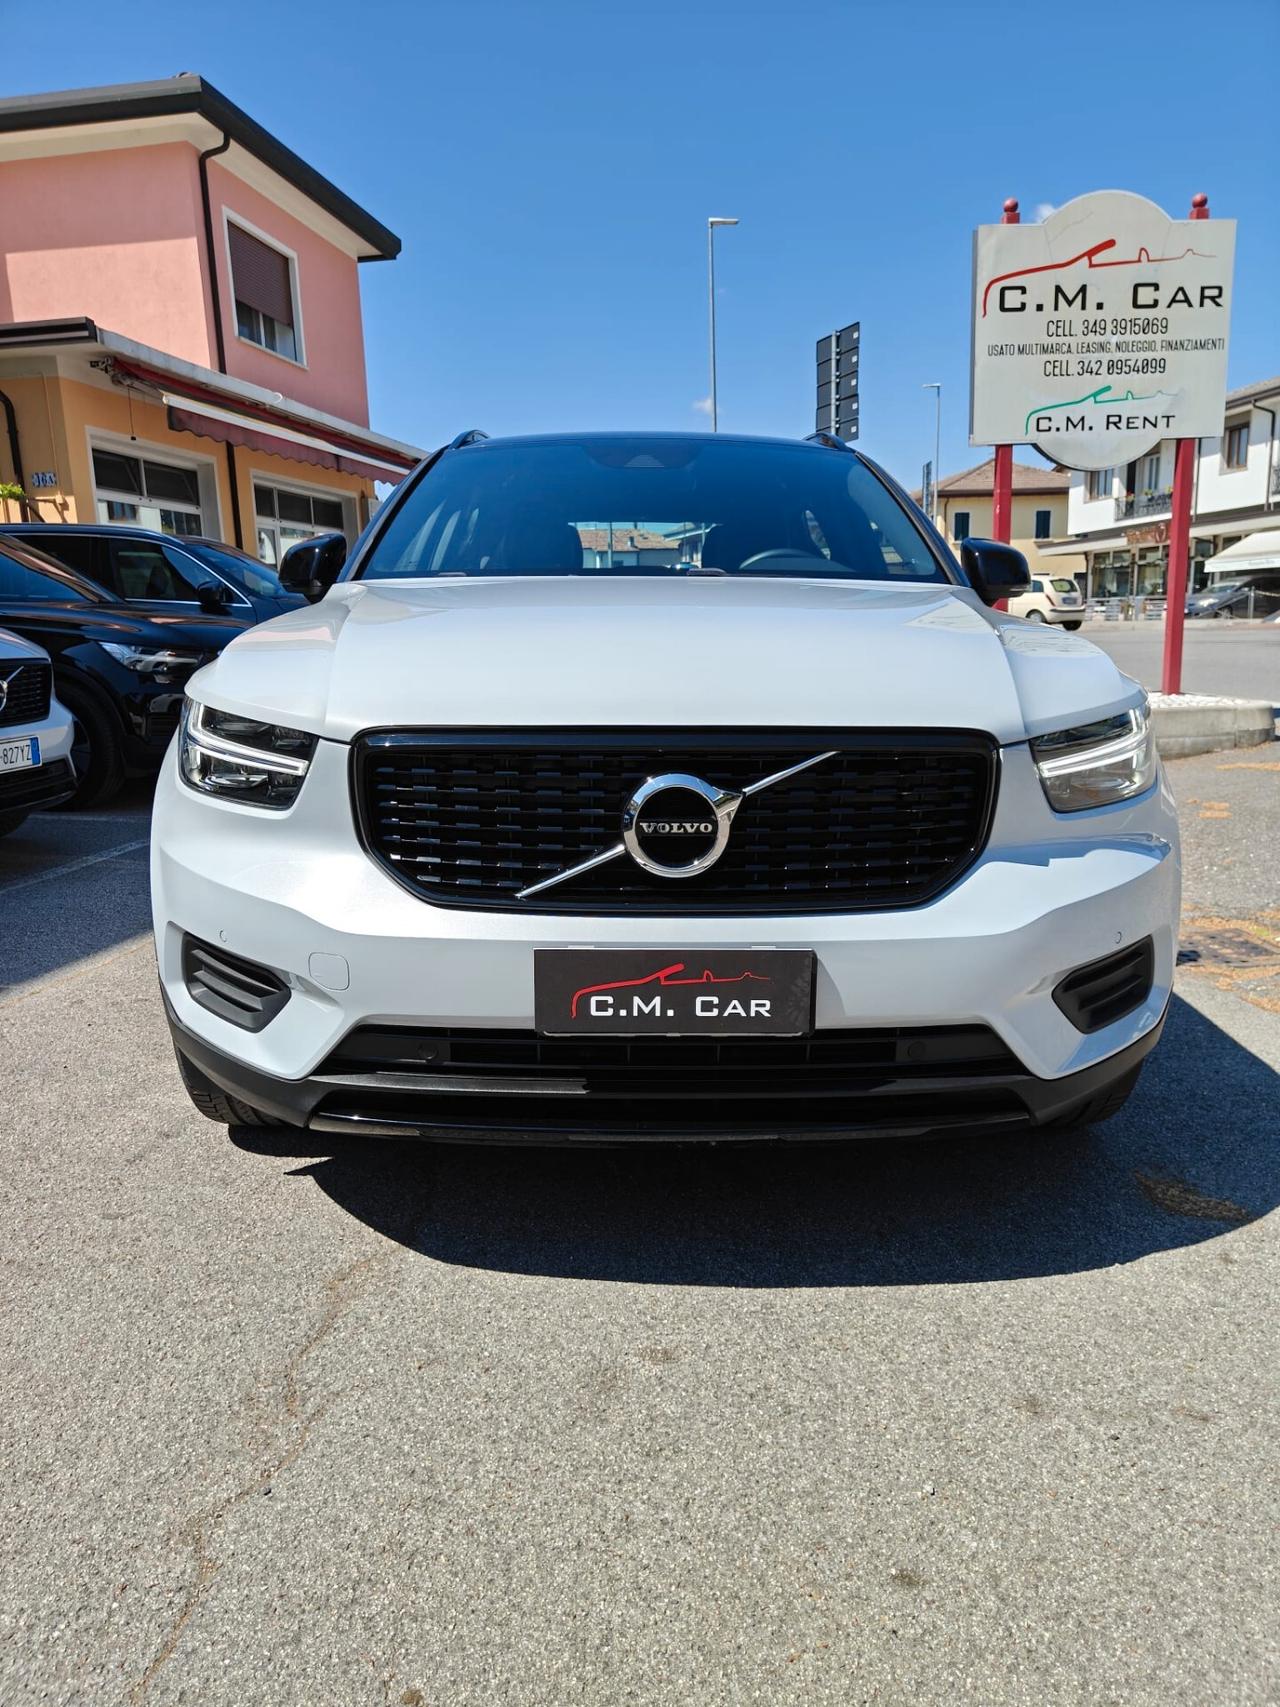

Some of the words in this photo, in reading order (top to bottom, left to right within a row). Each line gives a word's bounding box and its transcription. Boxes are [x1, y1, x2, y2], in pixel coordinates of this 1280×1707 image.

[999, 283, 1104, 312] C.M.
[1046, 319, 1078, 337] CELL.
[1082, 319, 1107, 336] 349
[1111, 317, 1168, 335] 3915069
[987, 343, 1015, 356] USATO
[1160, 338, 1225, 352] FINANZIAMENTI
[1043, 359, 1074, 377] CELL.
[1077, 359, 1103, 376] 342
[1107, 358, 1166, 375] 0954099
[1036, 415, 1093, 432] C.M.
[640, 822, 713, 834] VOLVO
[590, 995, 674, 1017] C.M.
